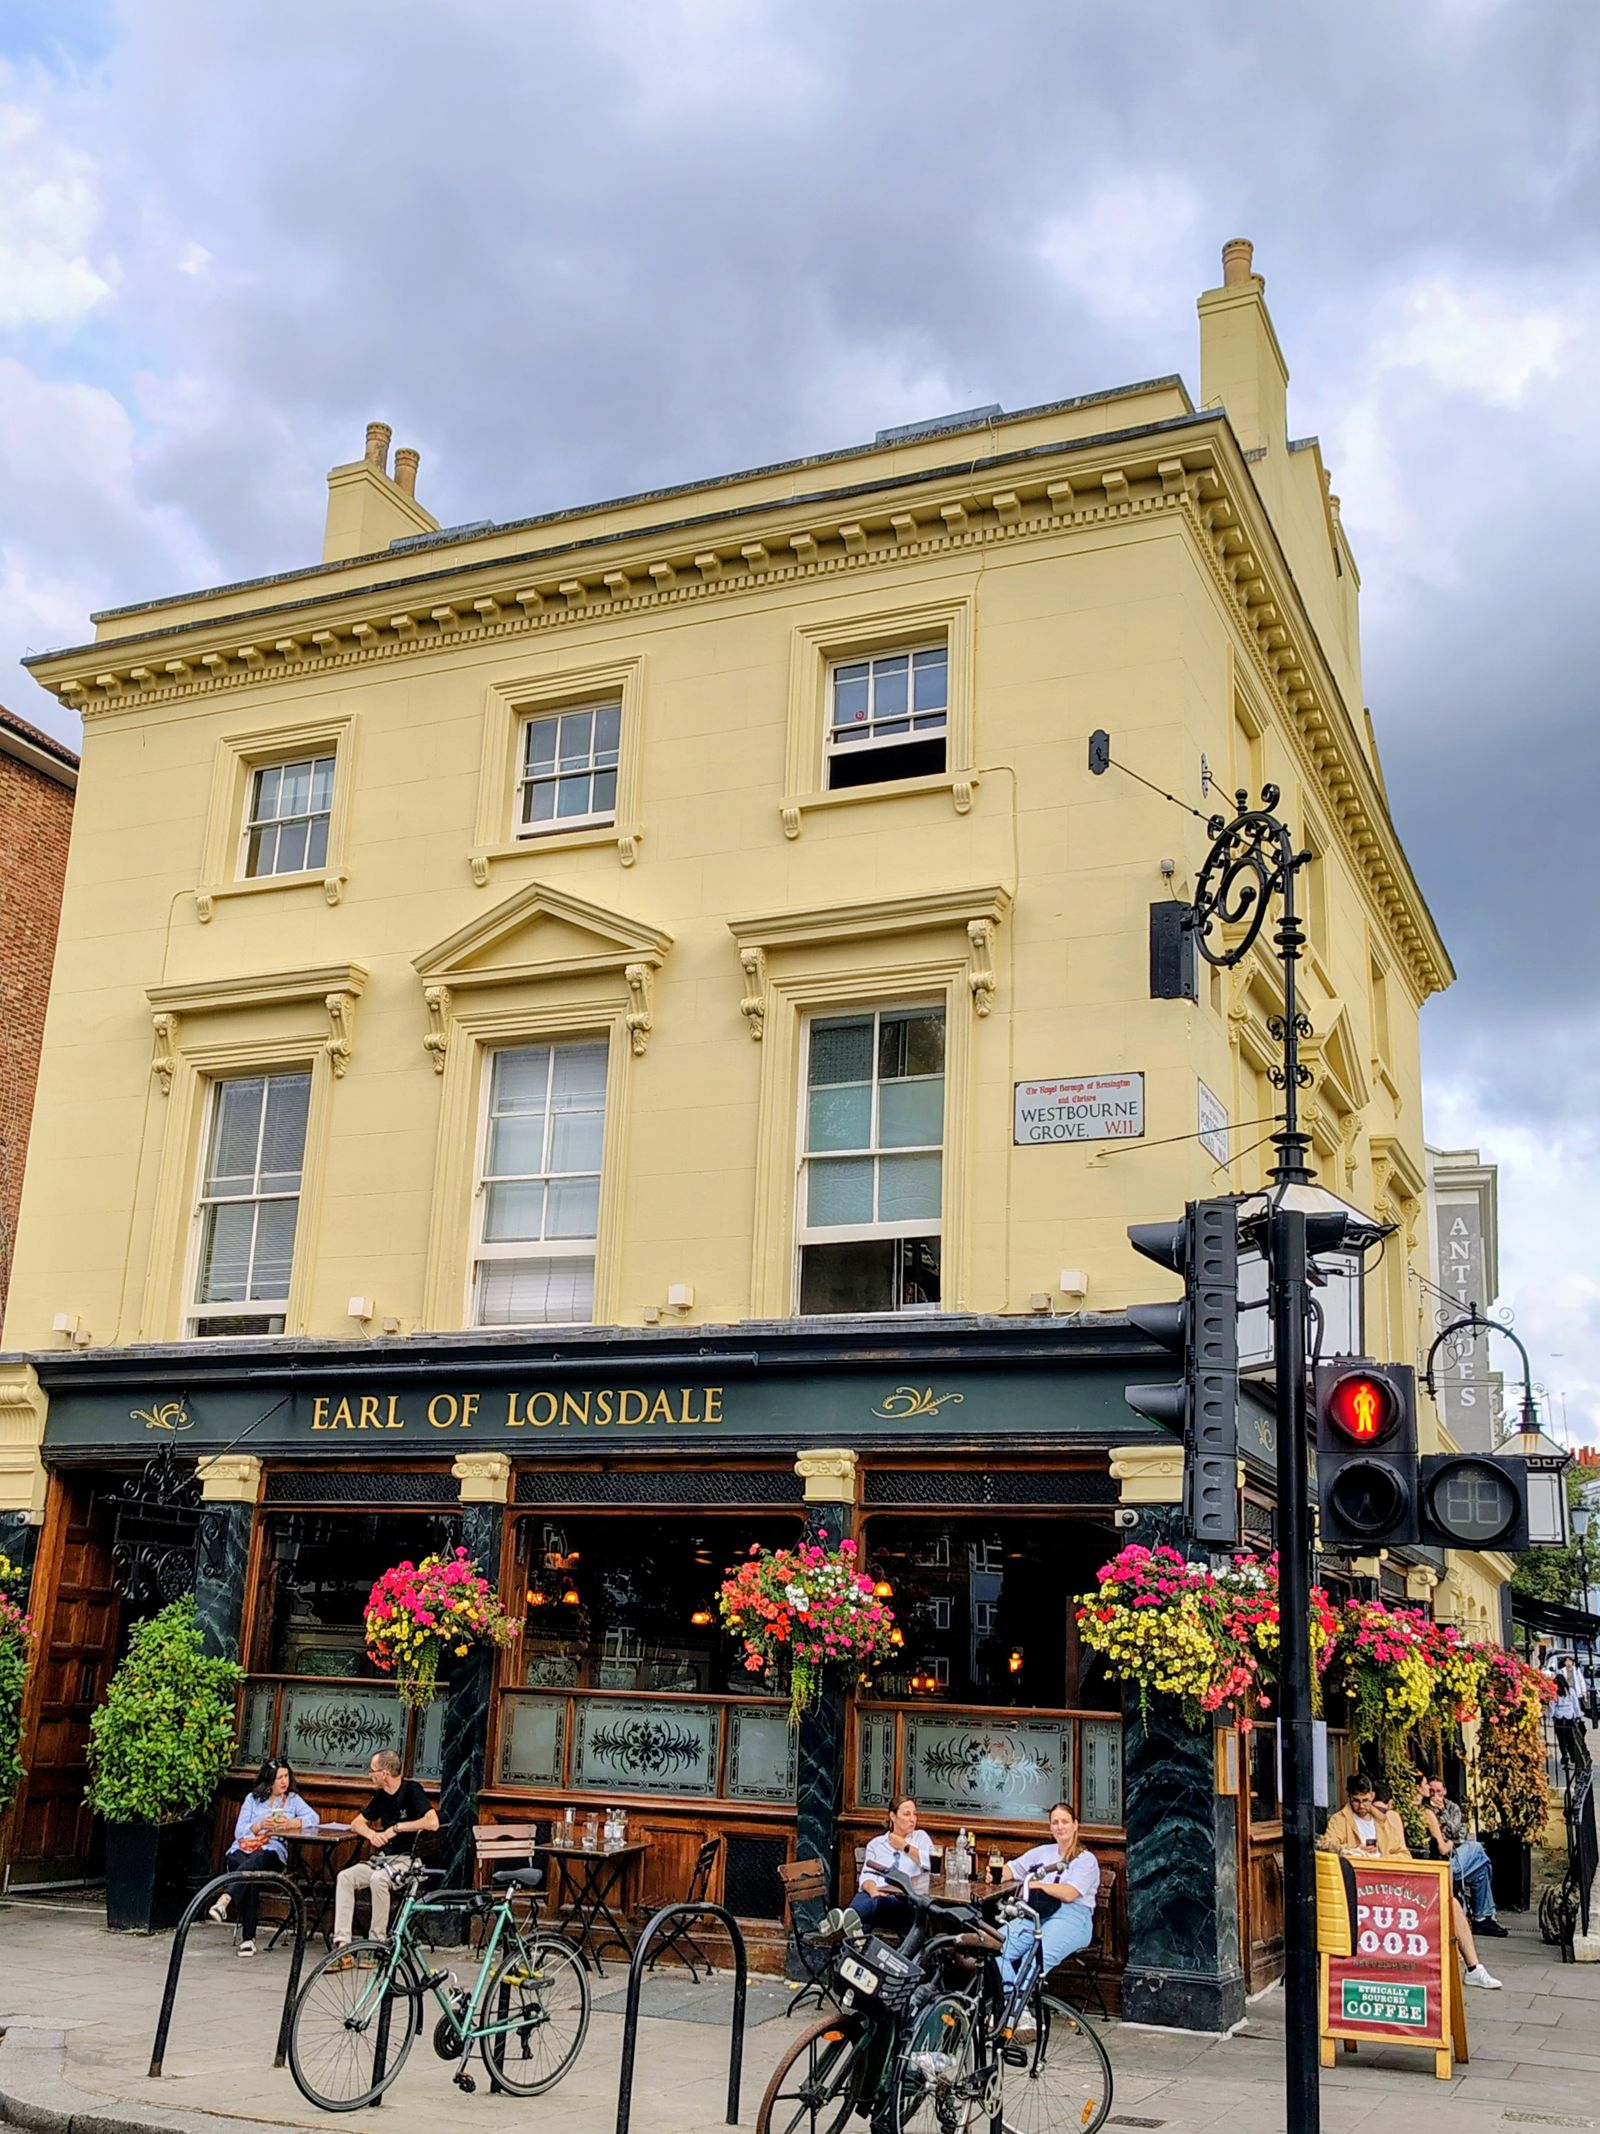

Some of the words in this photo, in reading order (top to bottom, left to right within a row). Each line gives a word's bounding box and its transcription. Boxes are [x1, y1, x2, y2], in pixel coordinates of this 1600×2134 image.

[1021, 1101, 1138, 1123] WESTBOURNE
[310, 1394, 405, 1431] EARL
[427, 1392, 481, 1430] OF
[505, 1386, 725, 1428] LONSDALE
[1357, 1884, 1428, 1909] ADITIONAL
[1357, 1905, 1419, 1930] PUB
[1358, 1930, 1430, 1957] OOD
[1358, 1985, 1410, 1996] ETHICALLY
[1362, 1994, 1406, 2004] SOURCED
[1346, 2001, 1422, 2020] COFFEE
